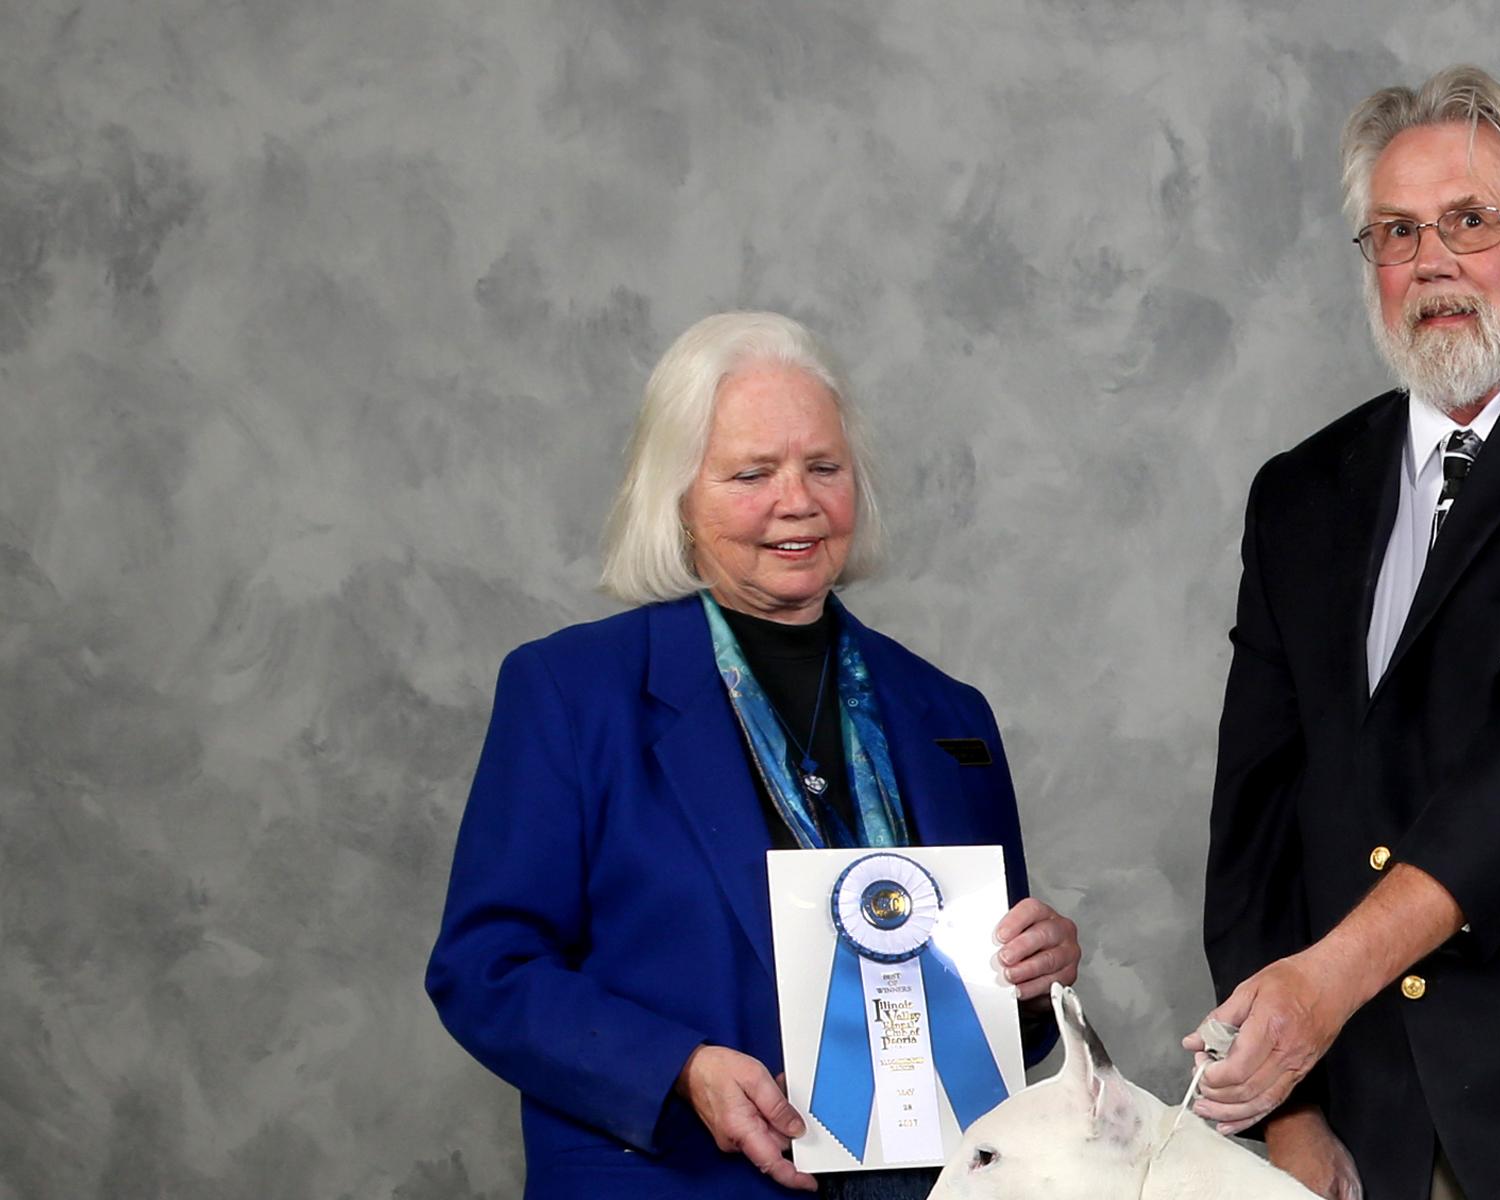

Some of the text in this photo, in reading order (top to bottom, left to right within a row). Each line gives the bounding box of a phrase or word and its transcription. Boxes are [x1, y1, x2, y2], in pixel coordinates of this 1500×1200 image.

[872, 998, 914, 1023] Illinois
[883, 1010, 921, 1032] Valley
[880, 1036, 918, 1050] Peoria
